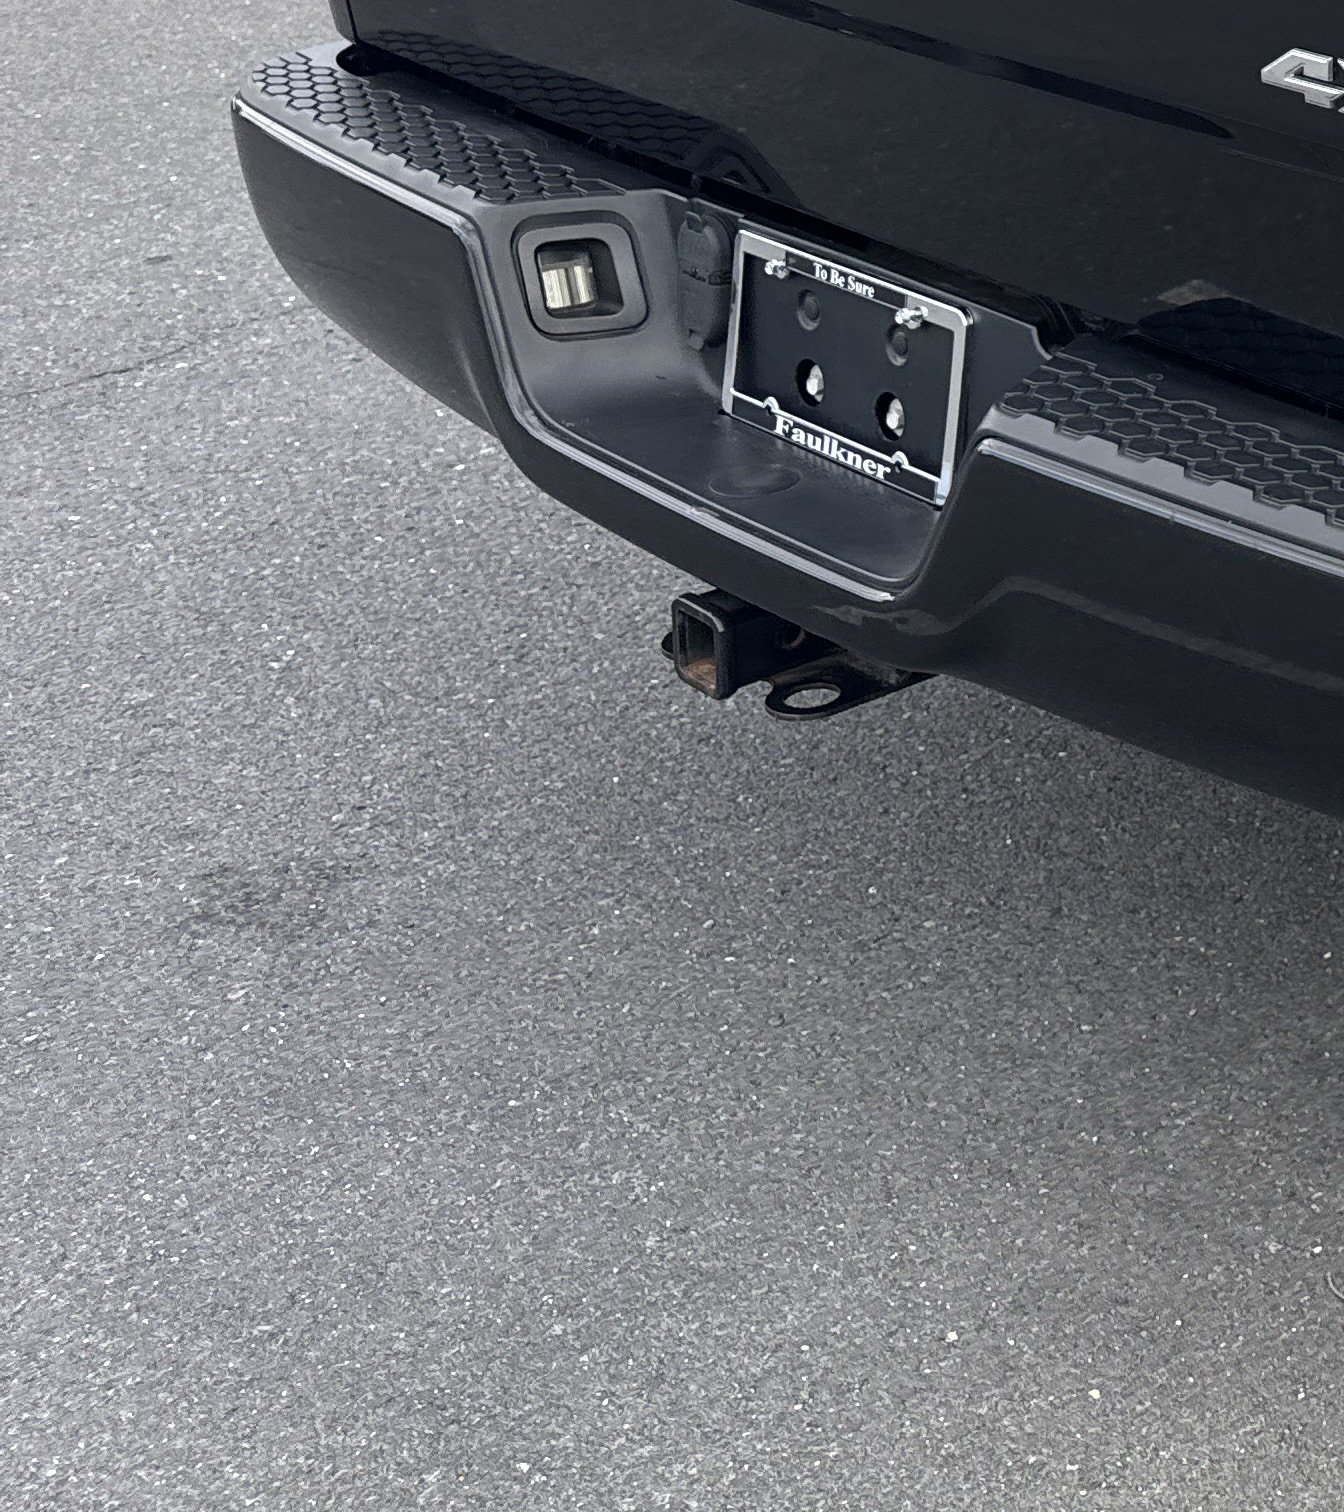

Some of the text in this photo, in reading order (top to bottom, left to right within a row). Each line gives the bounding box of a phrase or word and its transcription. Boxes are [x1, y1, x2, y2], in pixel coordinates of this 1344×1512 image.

[813, 263, 875, 298] To Be Sure
[773, 415, 891, 480] Faulkner
